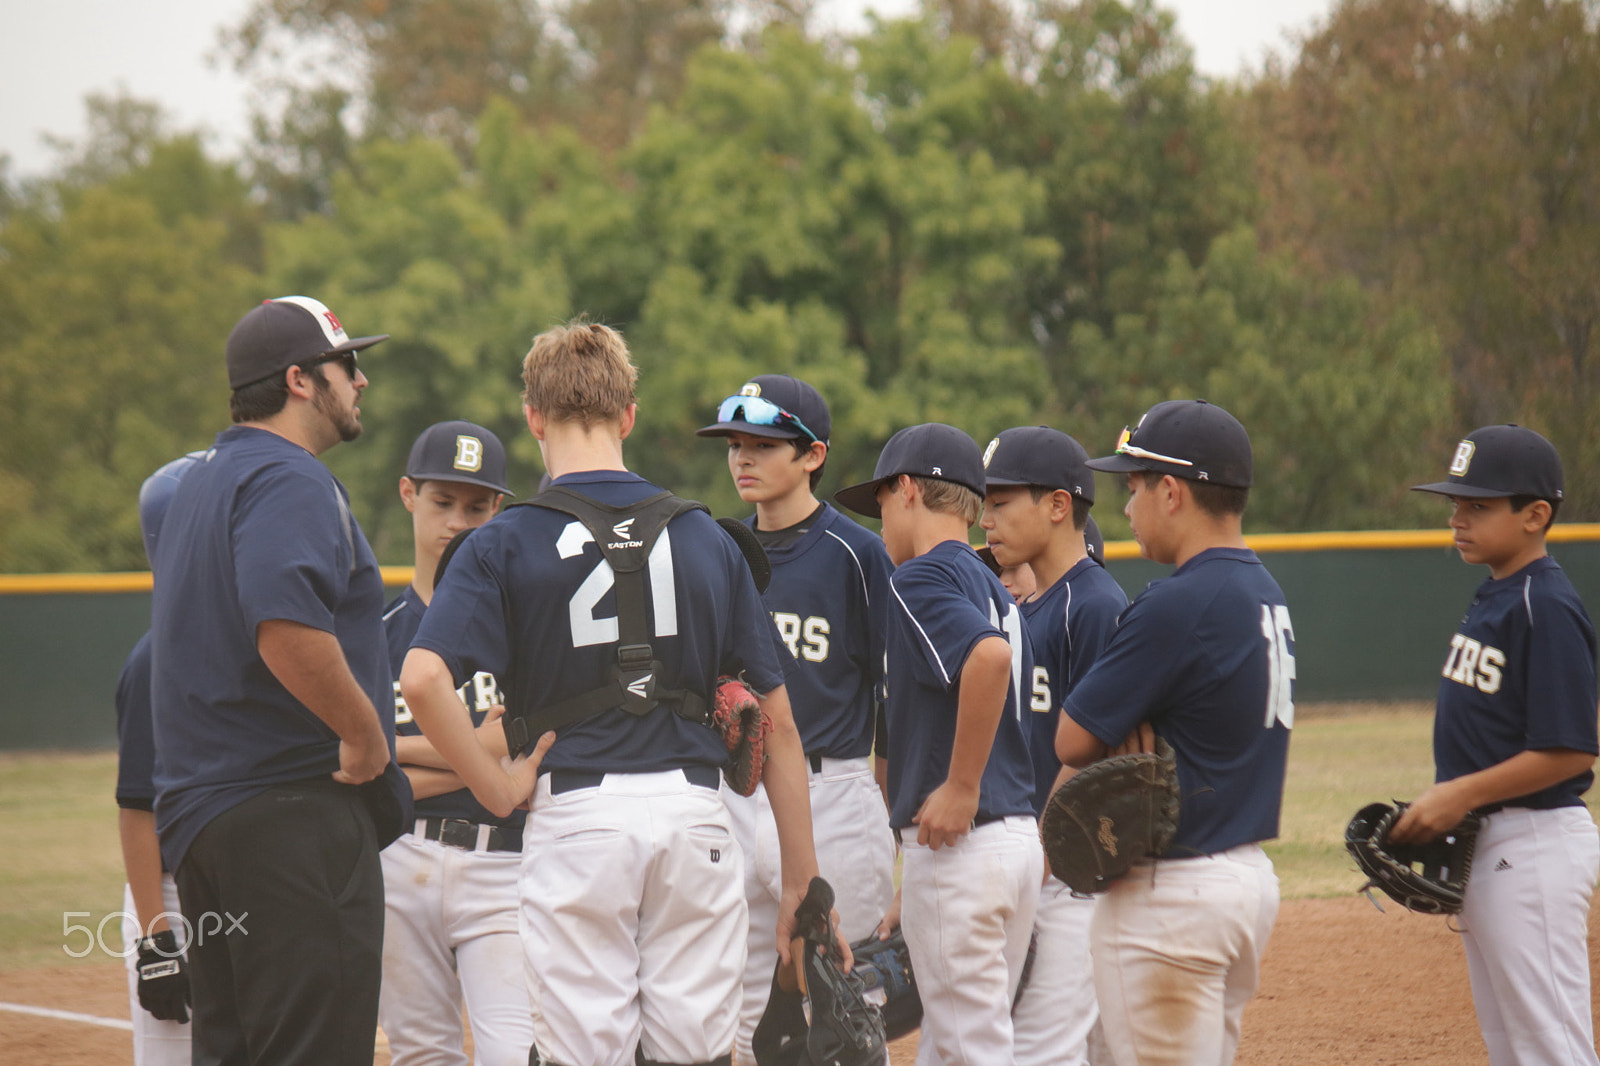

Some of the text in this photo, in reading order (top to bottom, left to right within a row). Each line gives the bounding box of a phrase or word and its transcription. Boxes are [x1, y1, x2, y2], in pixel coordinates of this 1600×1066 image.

[453, 434, 483, 473] B
[1449, 439, 1476, 477] B
[607, 540, 644, 550] EASTON
[555, 520, 678, 648] 21
[769, 611, 831, 663] RS
